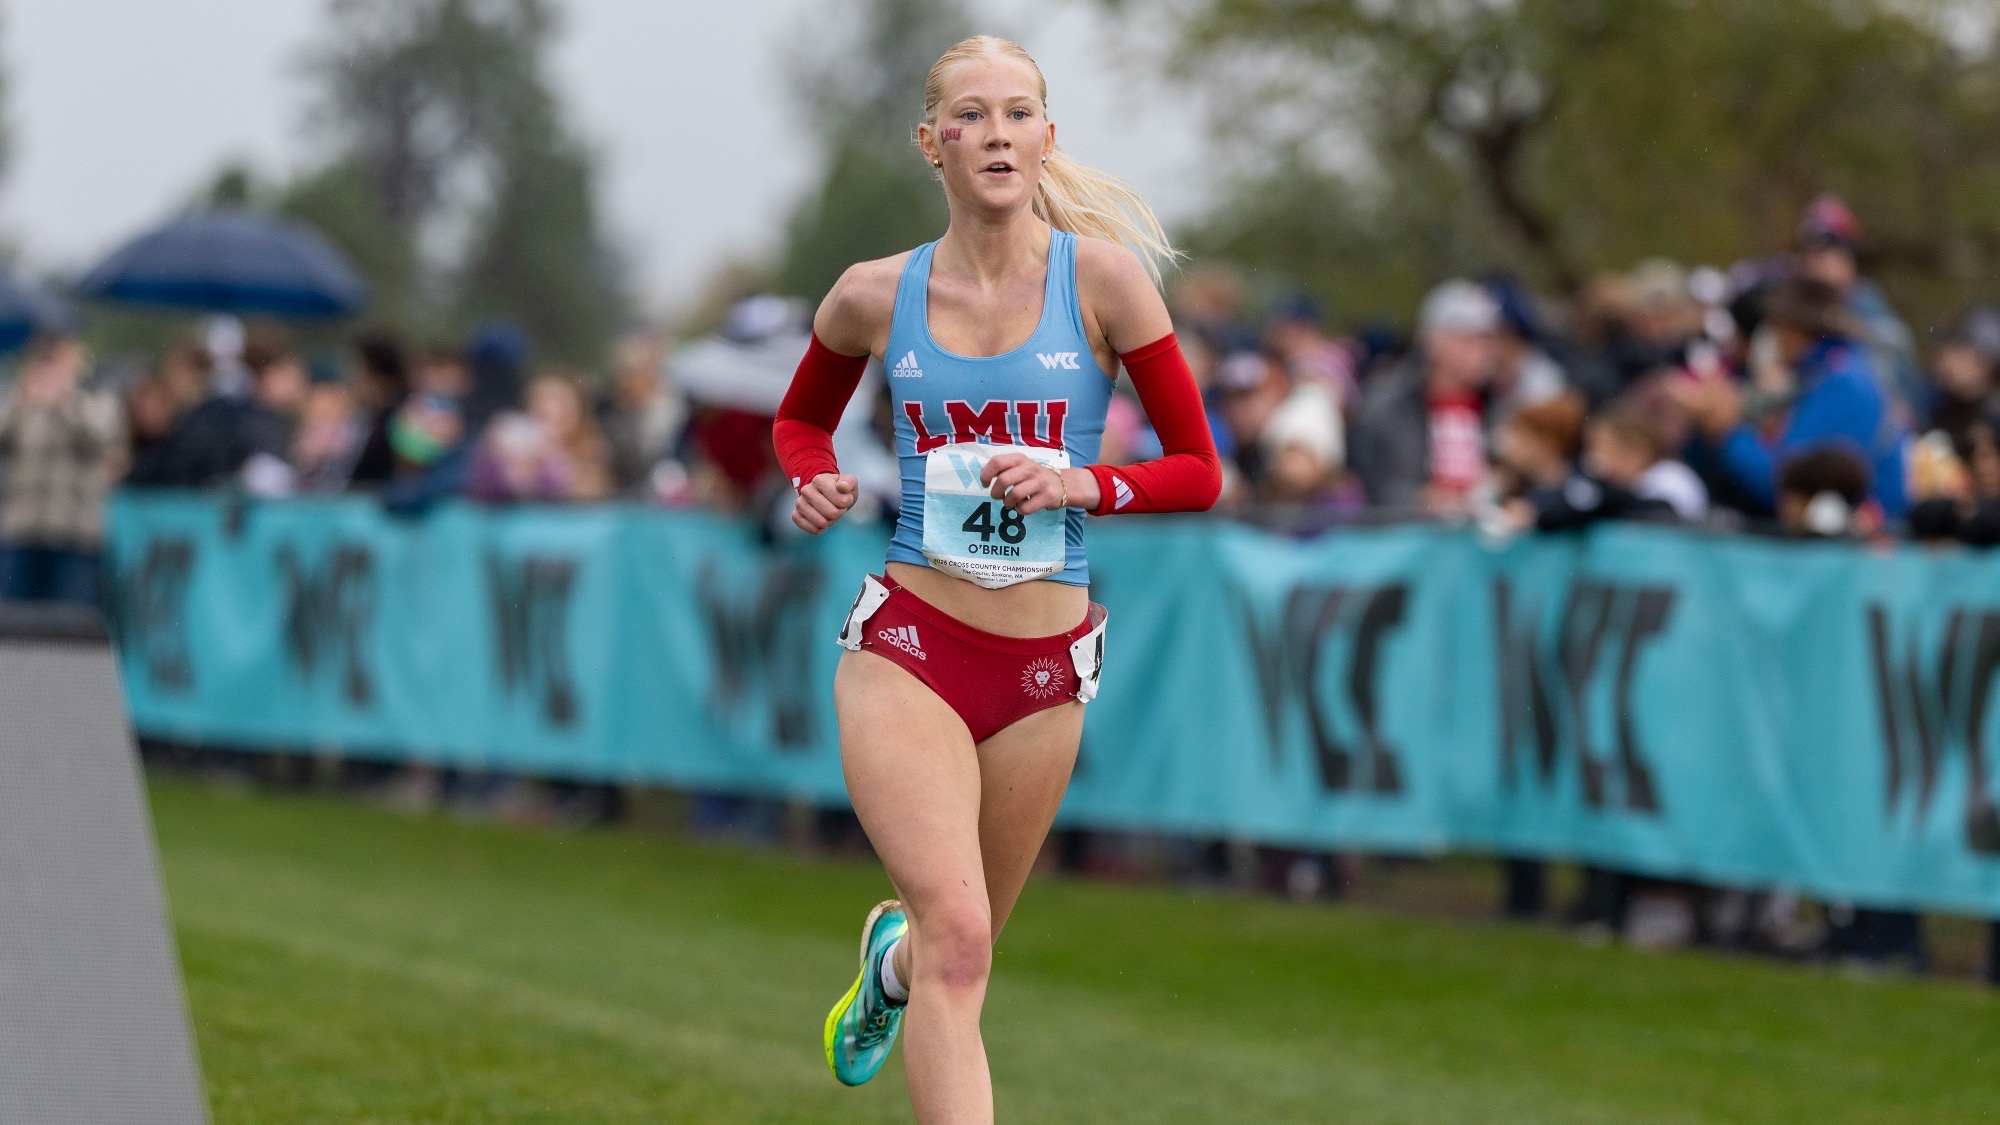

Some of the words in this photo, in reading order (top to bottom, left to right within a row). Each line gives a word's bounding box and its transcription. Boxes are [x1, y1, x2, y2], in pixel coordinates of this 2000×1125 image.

[1036, 352, 1080, 370] WCC
[893, 367, 923, 378] adidas
[903, 399, 1068, 455] LMU
[961, 501, 1027, 545] 48
[968, 543, 1020, 557] O'BRIEN
[948, 560, 970, 568] CROSS
[970, 563, 1001, 571] COUNTRY
[1001, 565, 1053, 573] CHAMPIONSHIPS
[878, 630, 927, 661] adidas
